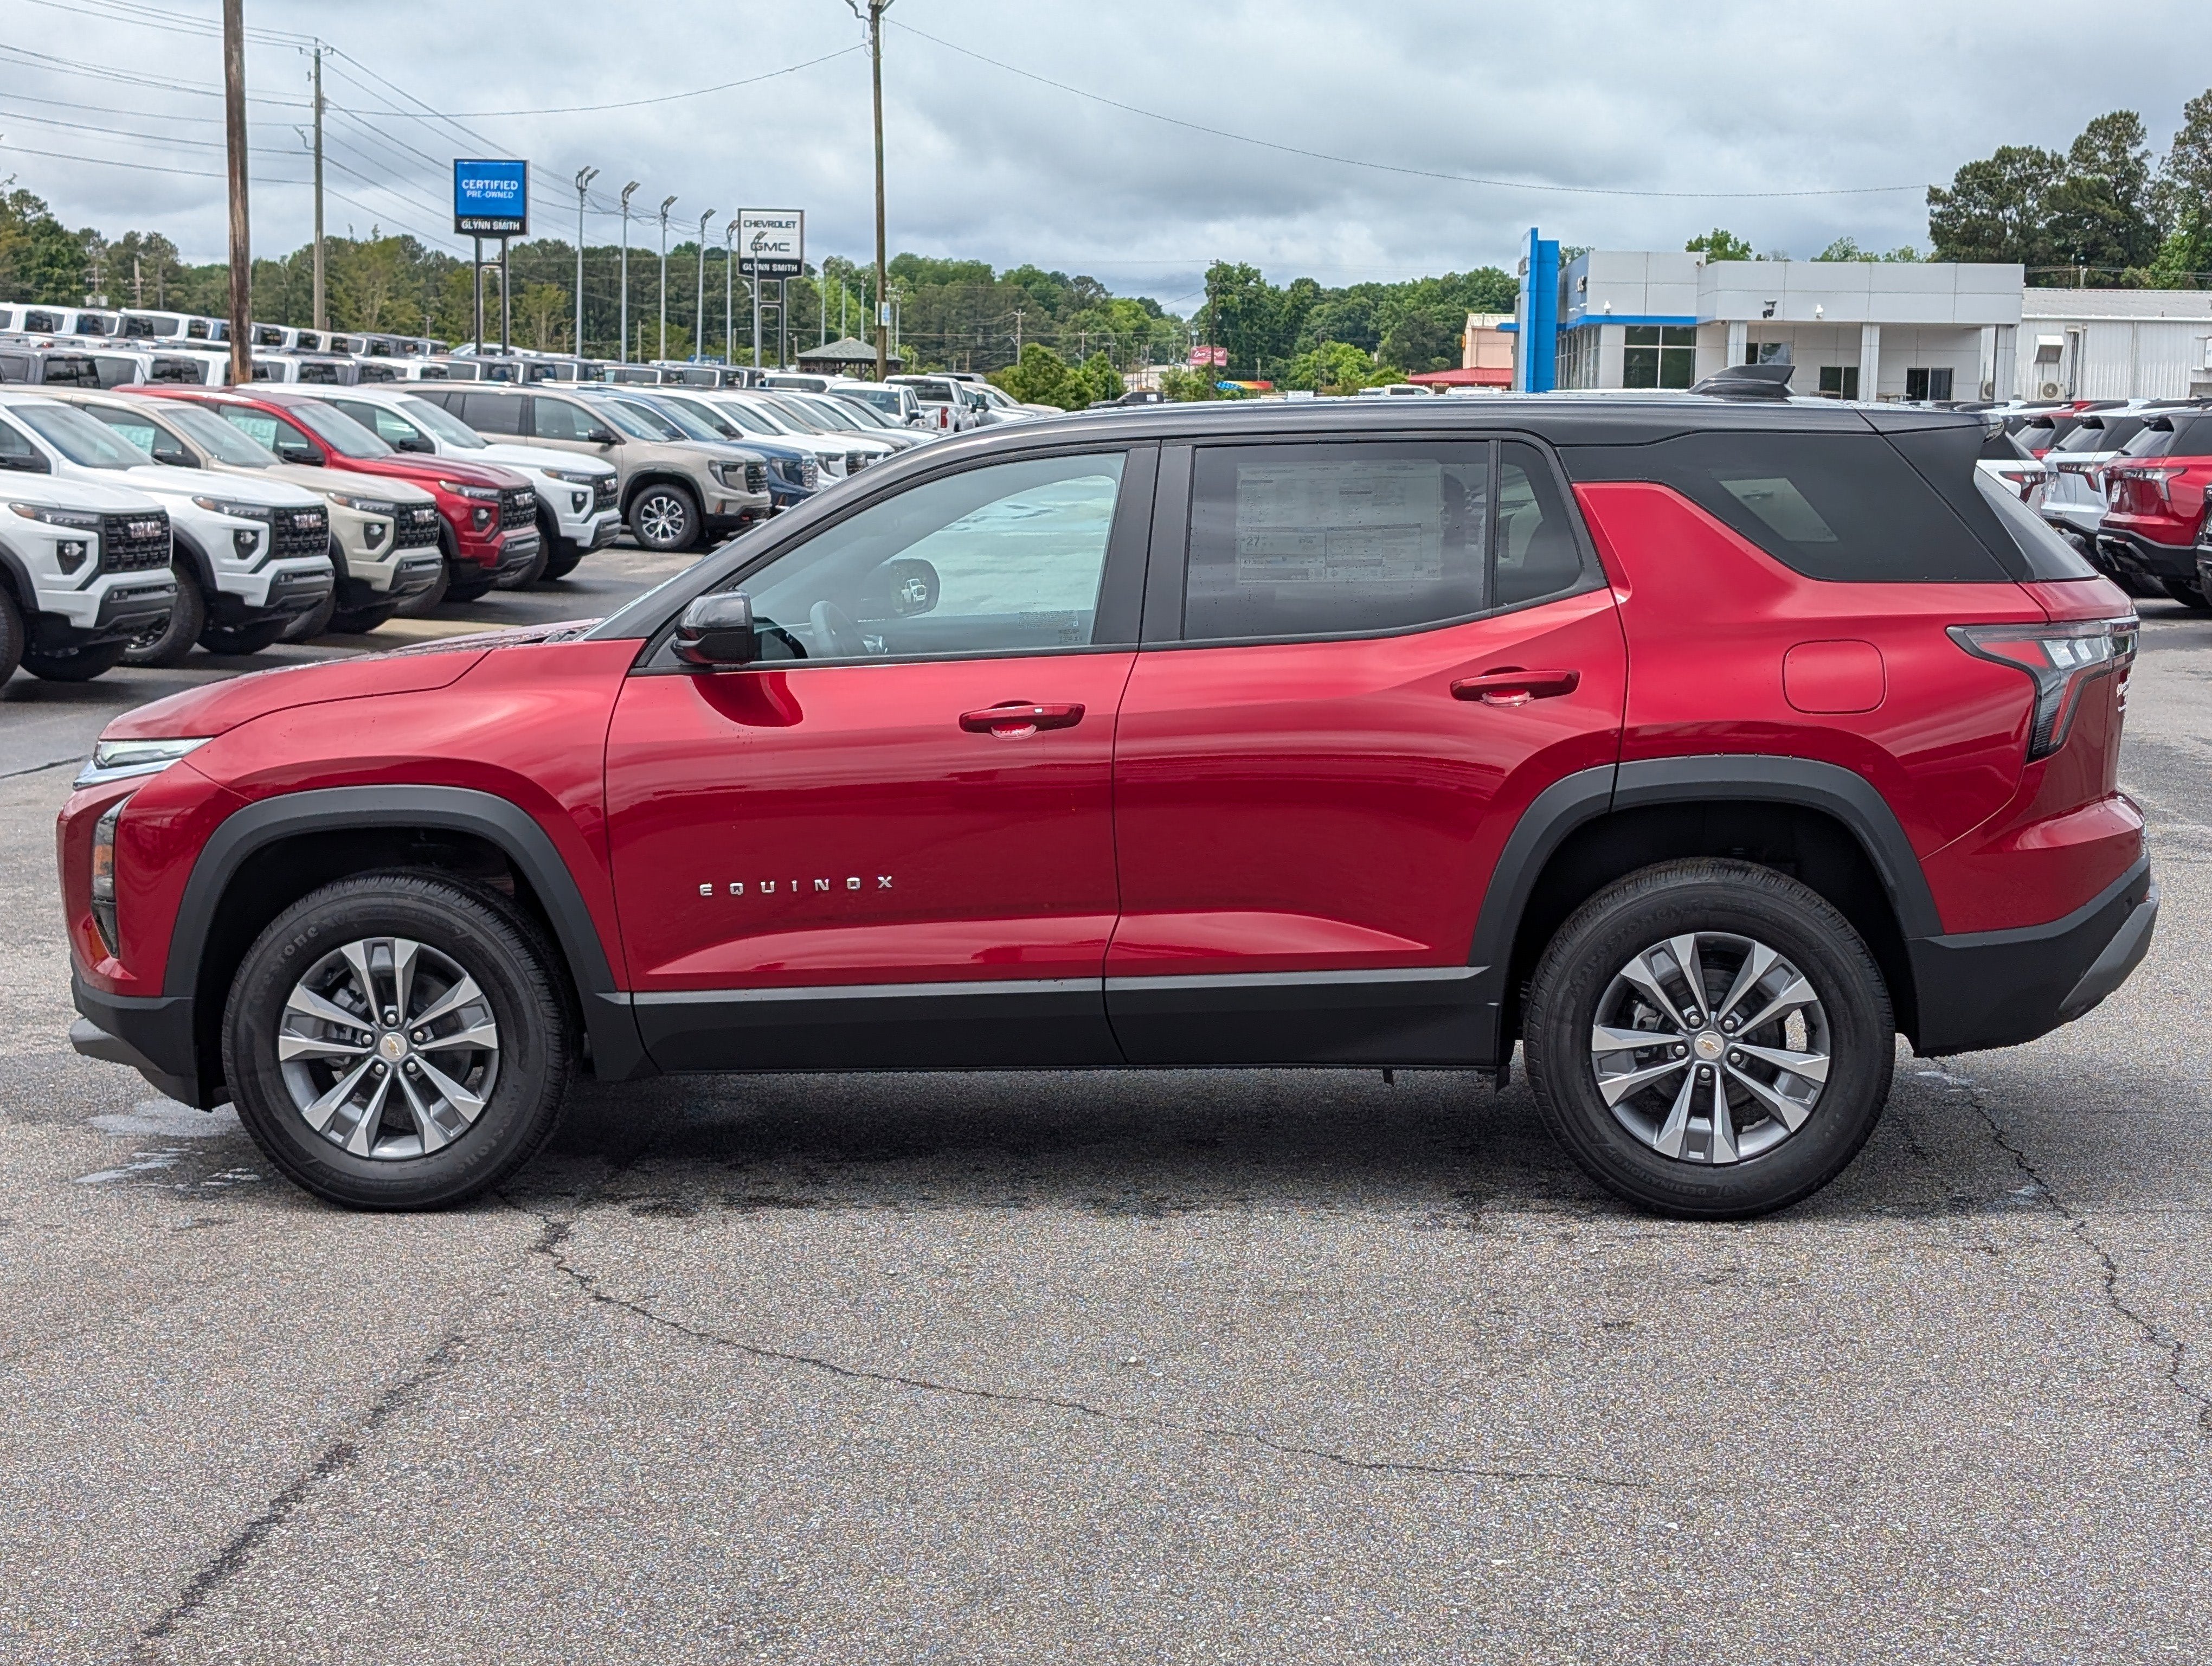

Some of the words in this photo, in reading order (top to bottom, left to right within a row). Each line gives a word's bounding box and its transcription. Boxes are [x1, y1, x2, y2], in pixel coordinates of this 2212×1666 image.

[461, 179, 518, 190] CERTIFIED
[466, 190, 514, 198] PRE-OWNED
[461, 220, 491, 229] GLYNN
[492, 221, 520, 230] SMITH
[743, 220, 797, 228] CHEVROLET
[750, 242, 790, 252] GMC
[772, 263, 798, 272] SMITH
[699, 875, 893, 896] EQUINOX
